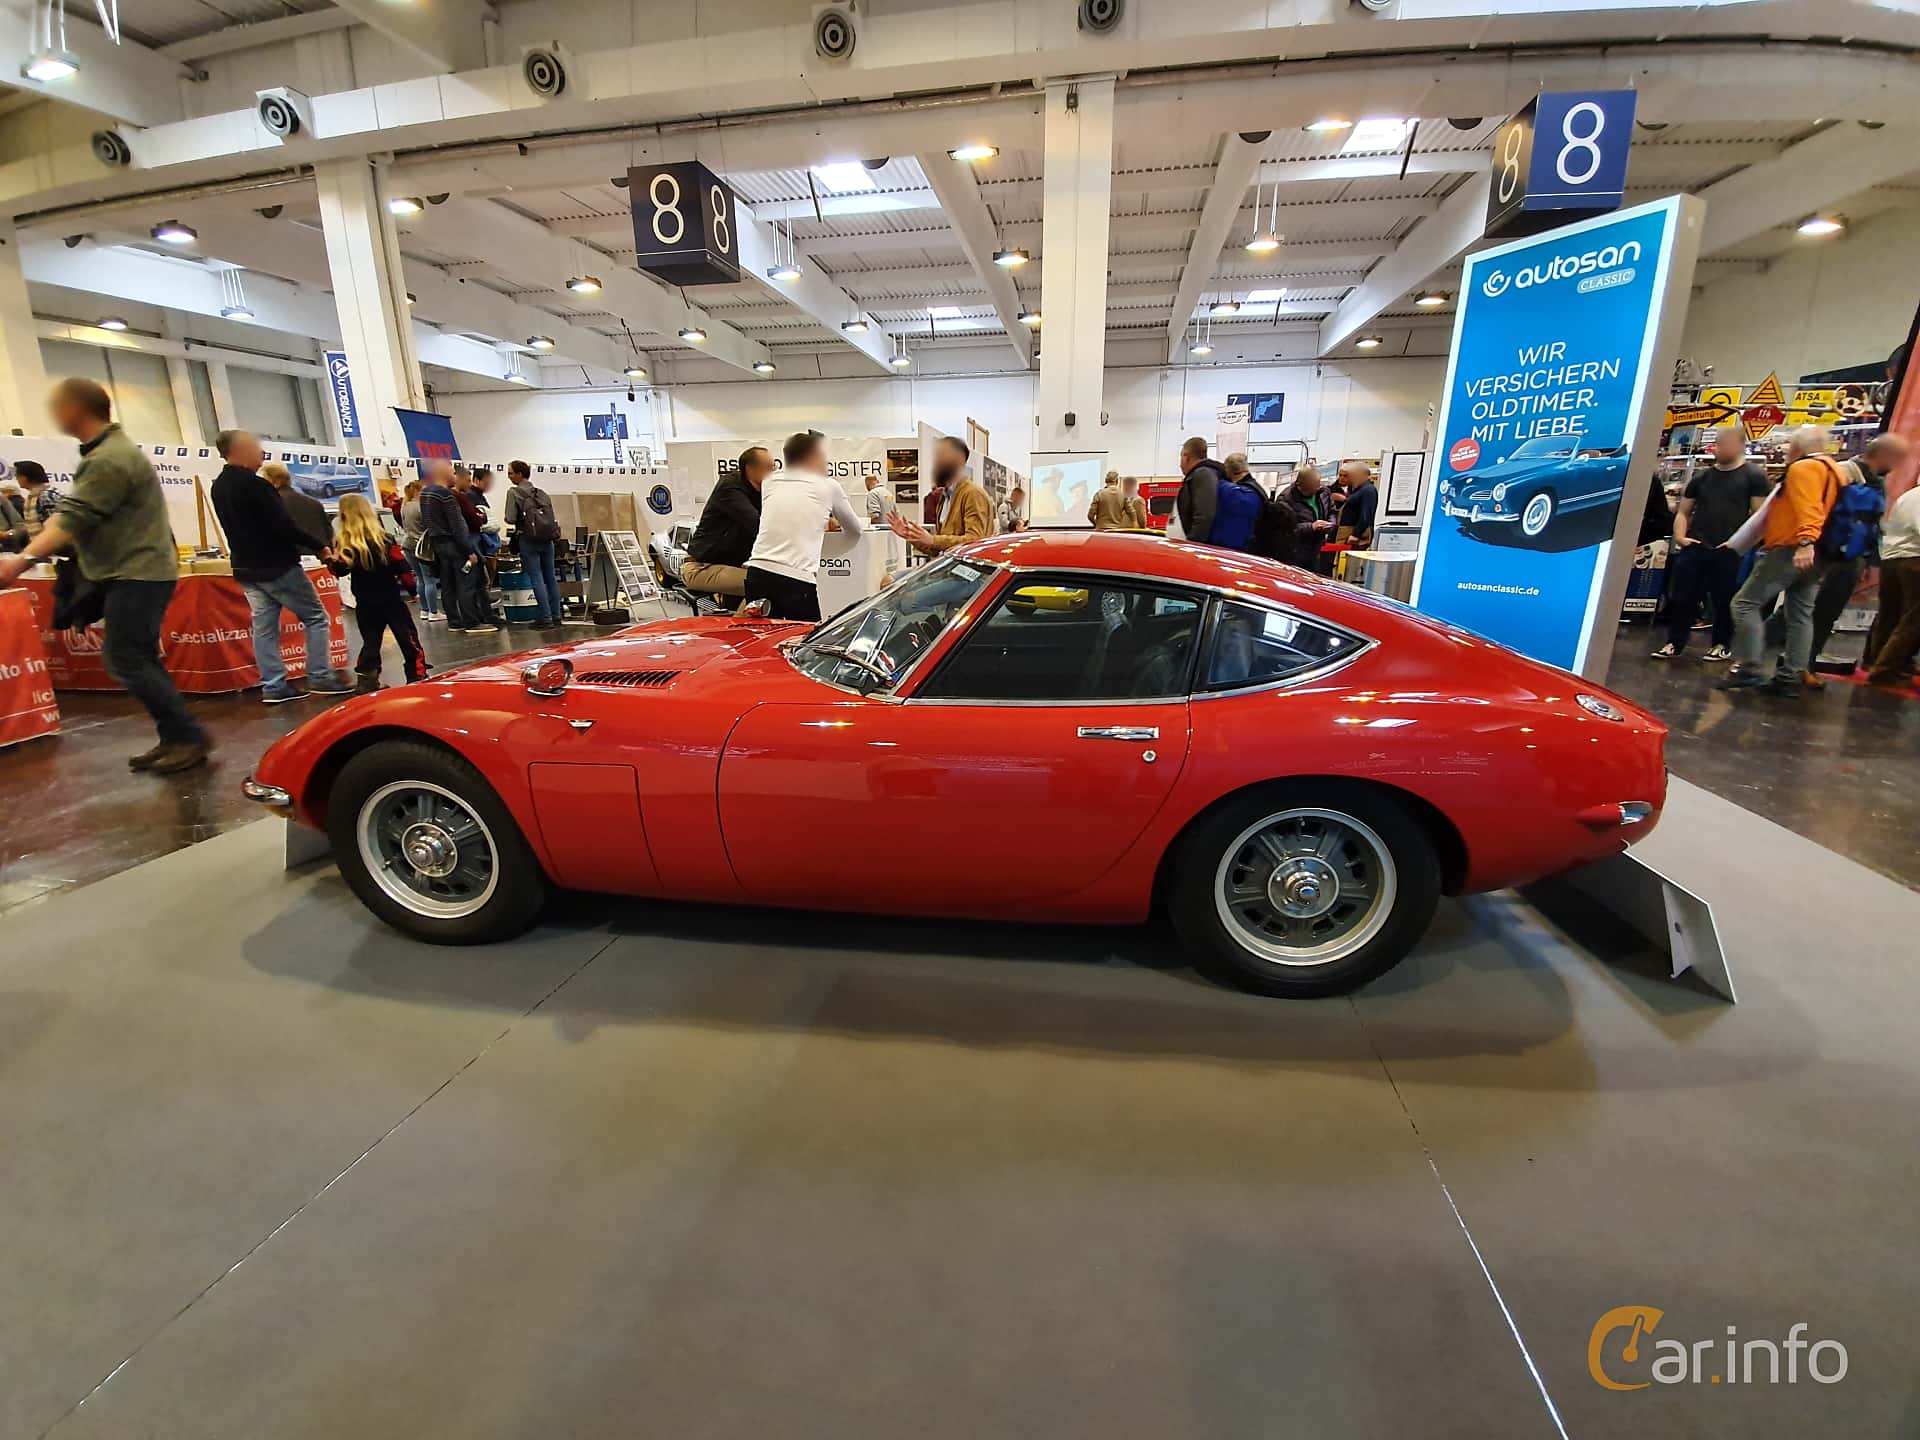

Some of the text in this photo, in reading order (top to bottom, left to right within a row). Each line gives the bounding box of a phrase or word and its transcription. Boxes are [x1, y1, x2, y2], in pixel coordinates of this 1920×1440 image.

[1499, 123, 1522, 204] 8
[1556, 102, 1605, 185] 8
[650, 173, 684, 245] 8
[710, 184, 730, 254] 8
[1515, 240, 1641, 289] autosan
[1579, 271, 1632, 291] CLASSIC
[1518, 341, 1566, 367] WIR
[1465, 358, 1621, 398] VERSICHERN
[1471, 388, 1599, 420] OLDTIMER.
[1471, 414, 1589, 443] MIT LIEBE.
[1457, 581, 1540, 596] autosanclassic.de
